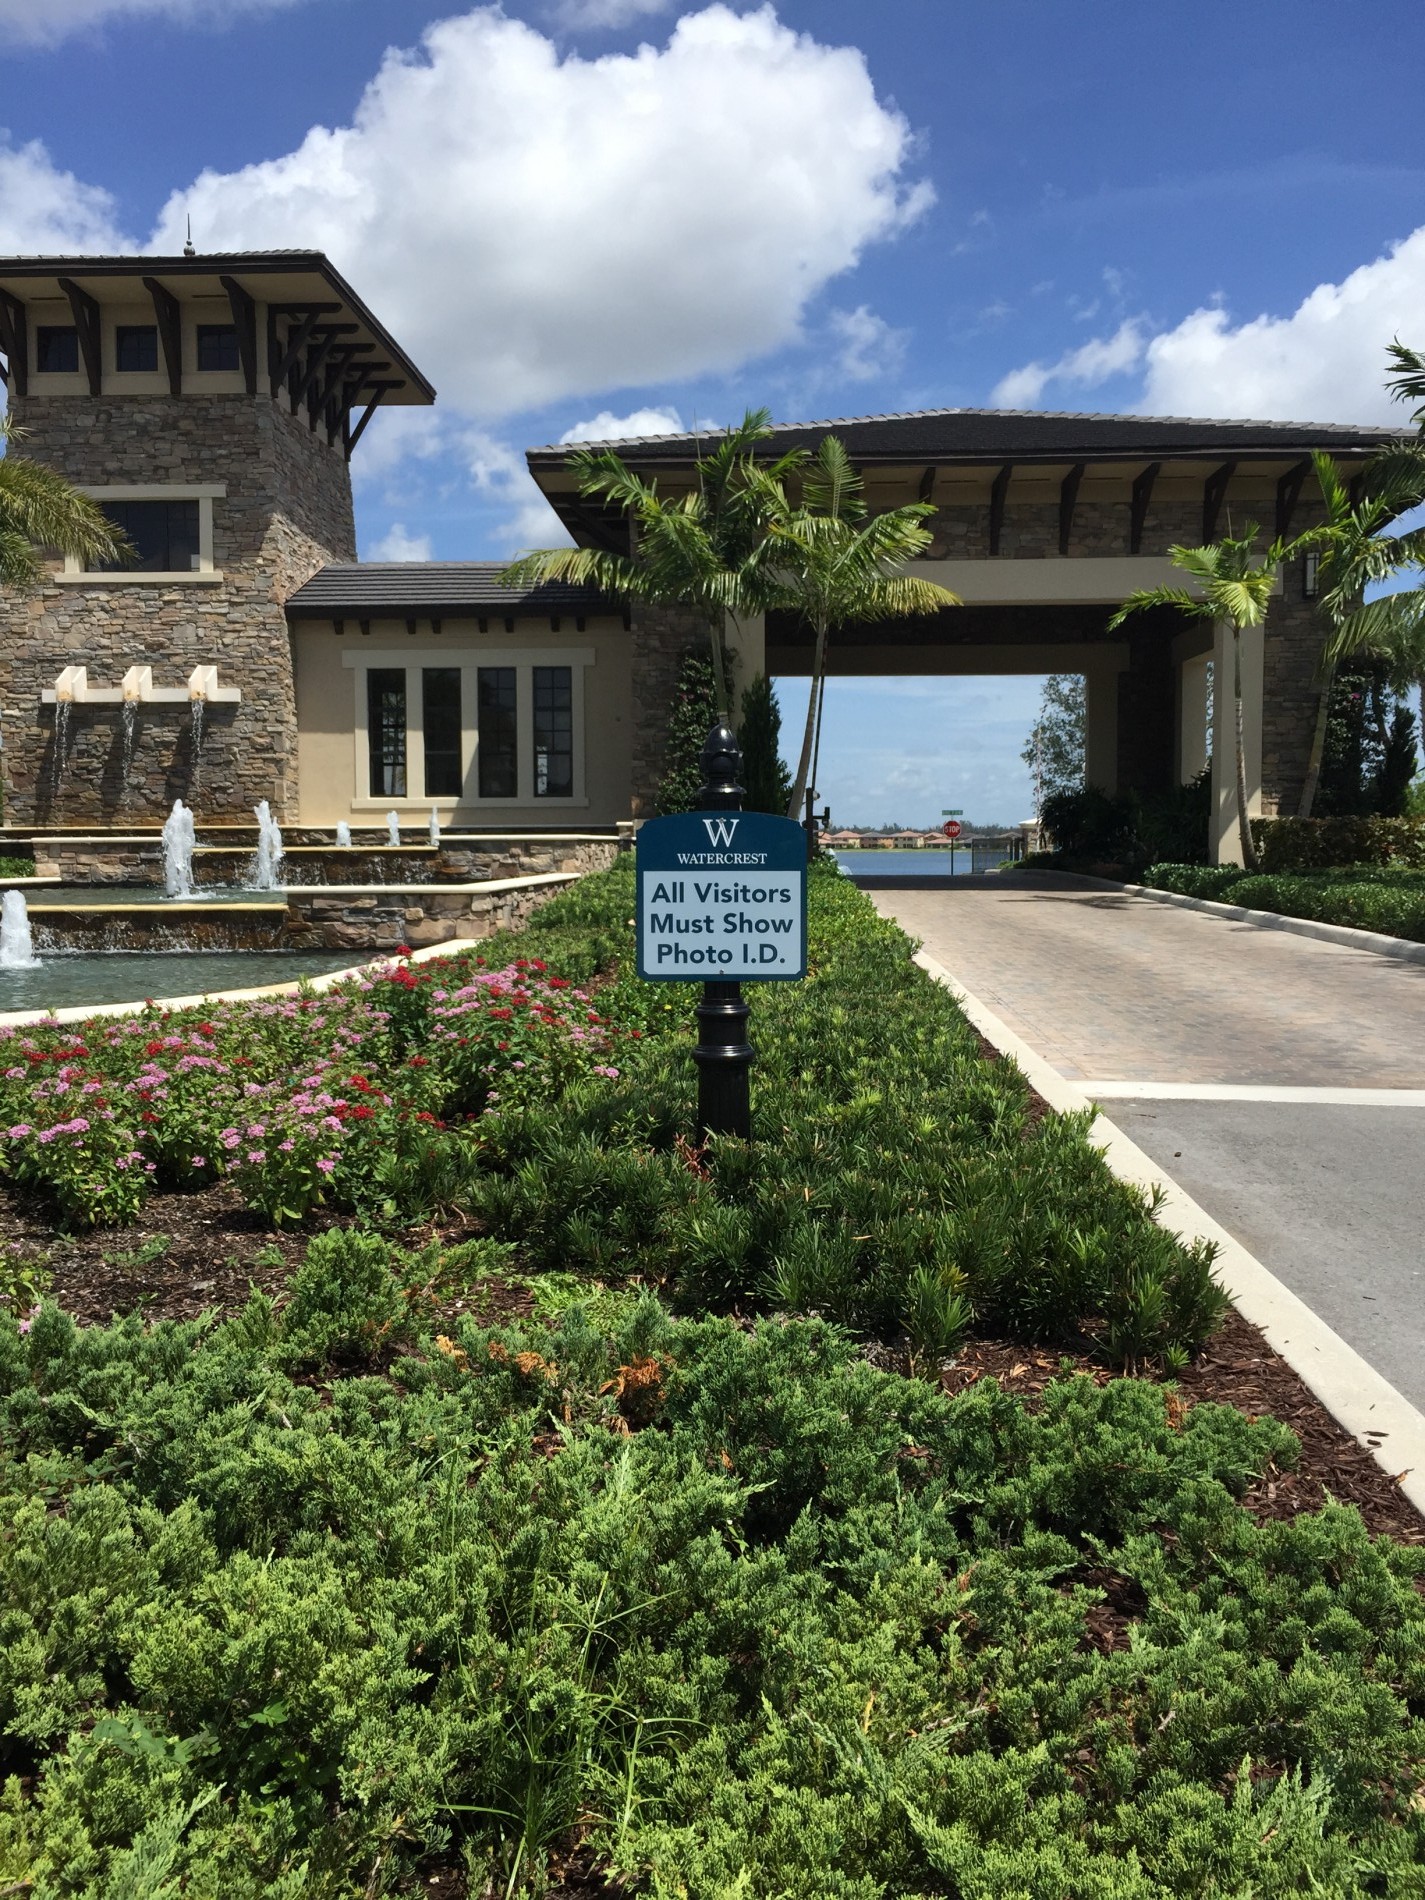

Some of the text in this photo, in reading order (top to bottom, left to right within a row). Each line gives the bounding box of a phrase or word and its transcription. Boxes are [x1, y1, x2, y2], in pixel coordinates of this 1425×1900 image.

[702, 818, 740, 848] W
[944, 825, 961, 834] STOP
[677, 853, 767, 865] WATERCREST
[651, 882, 791, 903] All Visitors
[650, 912, 794, 934] Must Show
[657, 943, 785, 964] Photo I.D.
